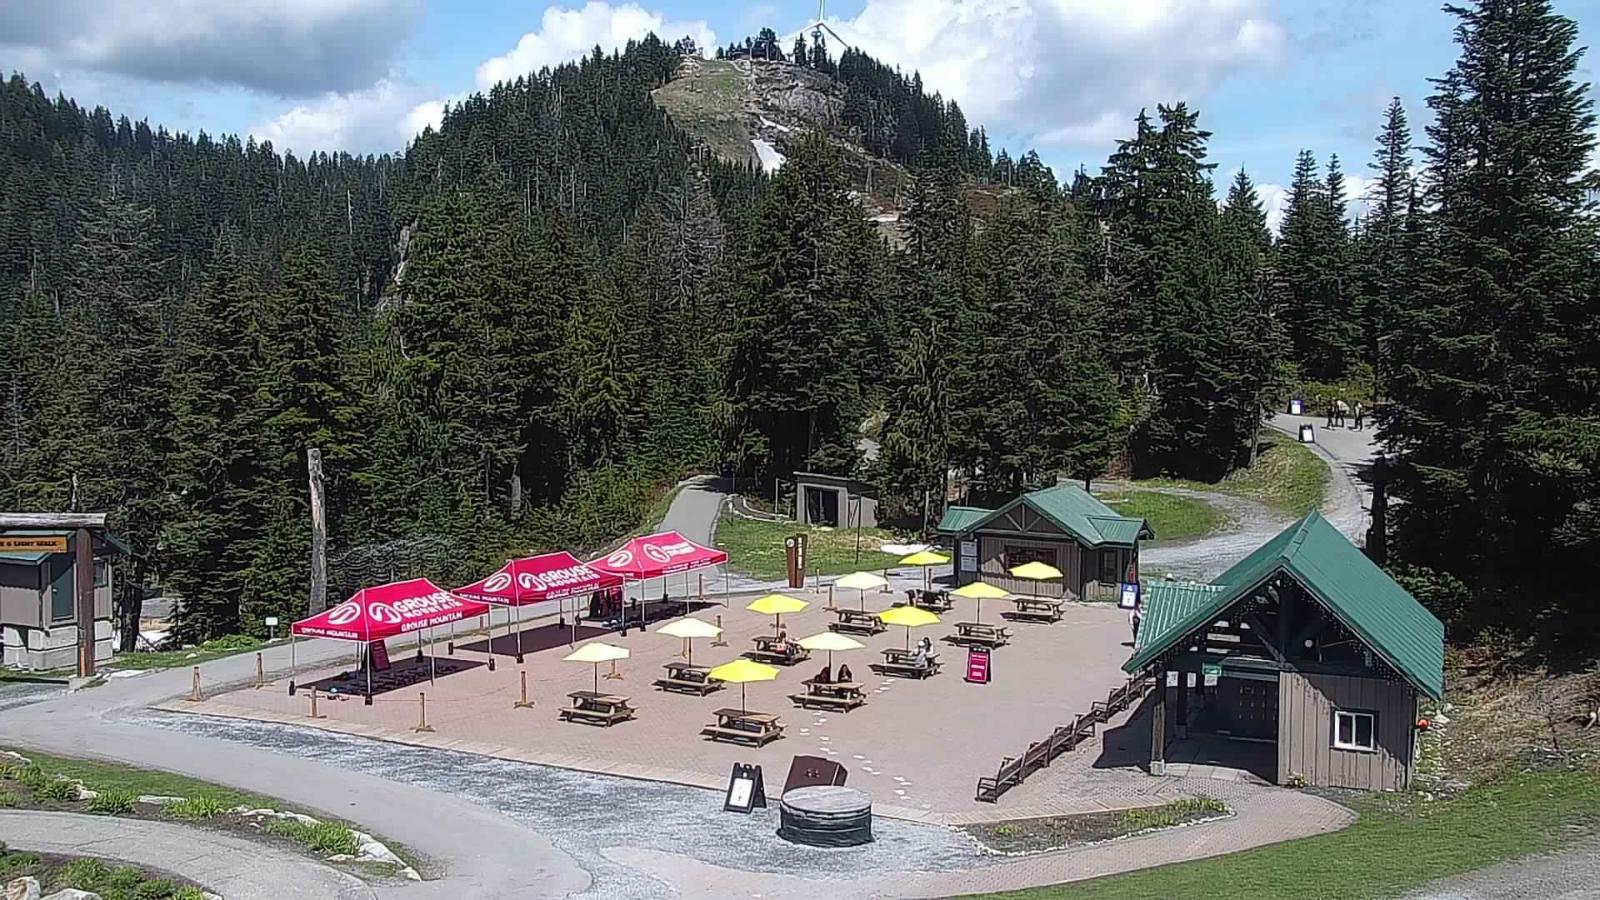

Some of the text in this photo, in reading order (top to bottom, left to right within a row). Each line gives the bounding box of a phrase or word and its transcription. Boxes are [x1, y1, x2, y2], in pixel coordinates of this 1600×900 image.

[539, 565, 594, 583] GROUSE
[393, 591, 455, 613] GROUSE
[402, 600, 464, 618] MOUNTAIN
[400, 611, 463, 632] GROUSE MOUNTAIN
